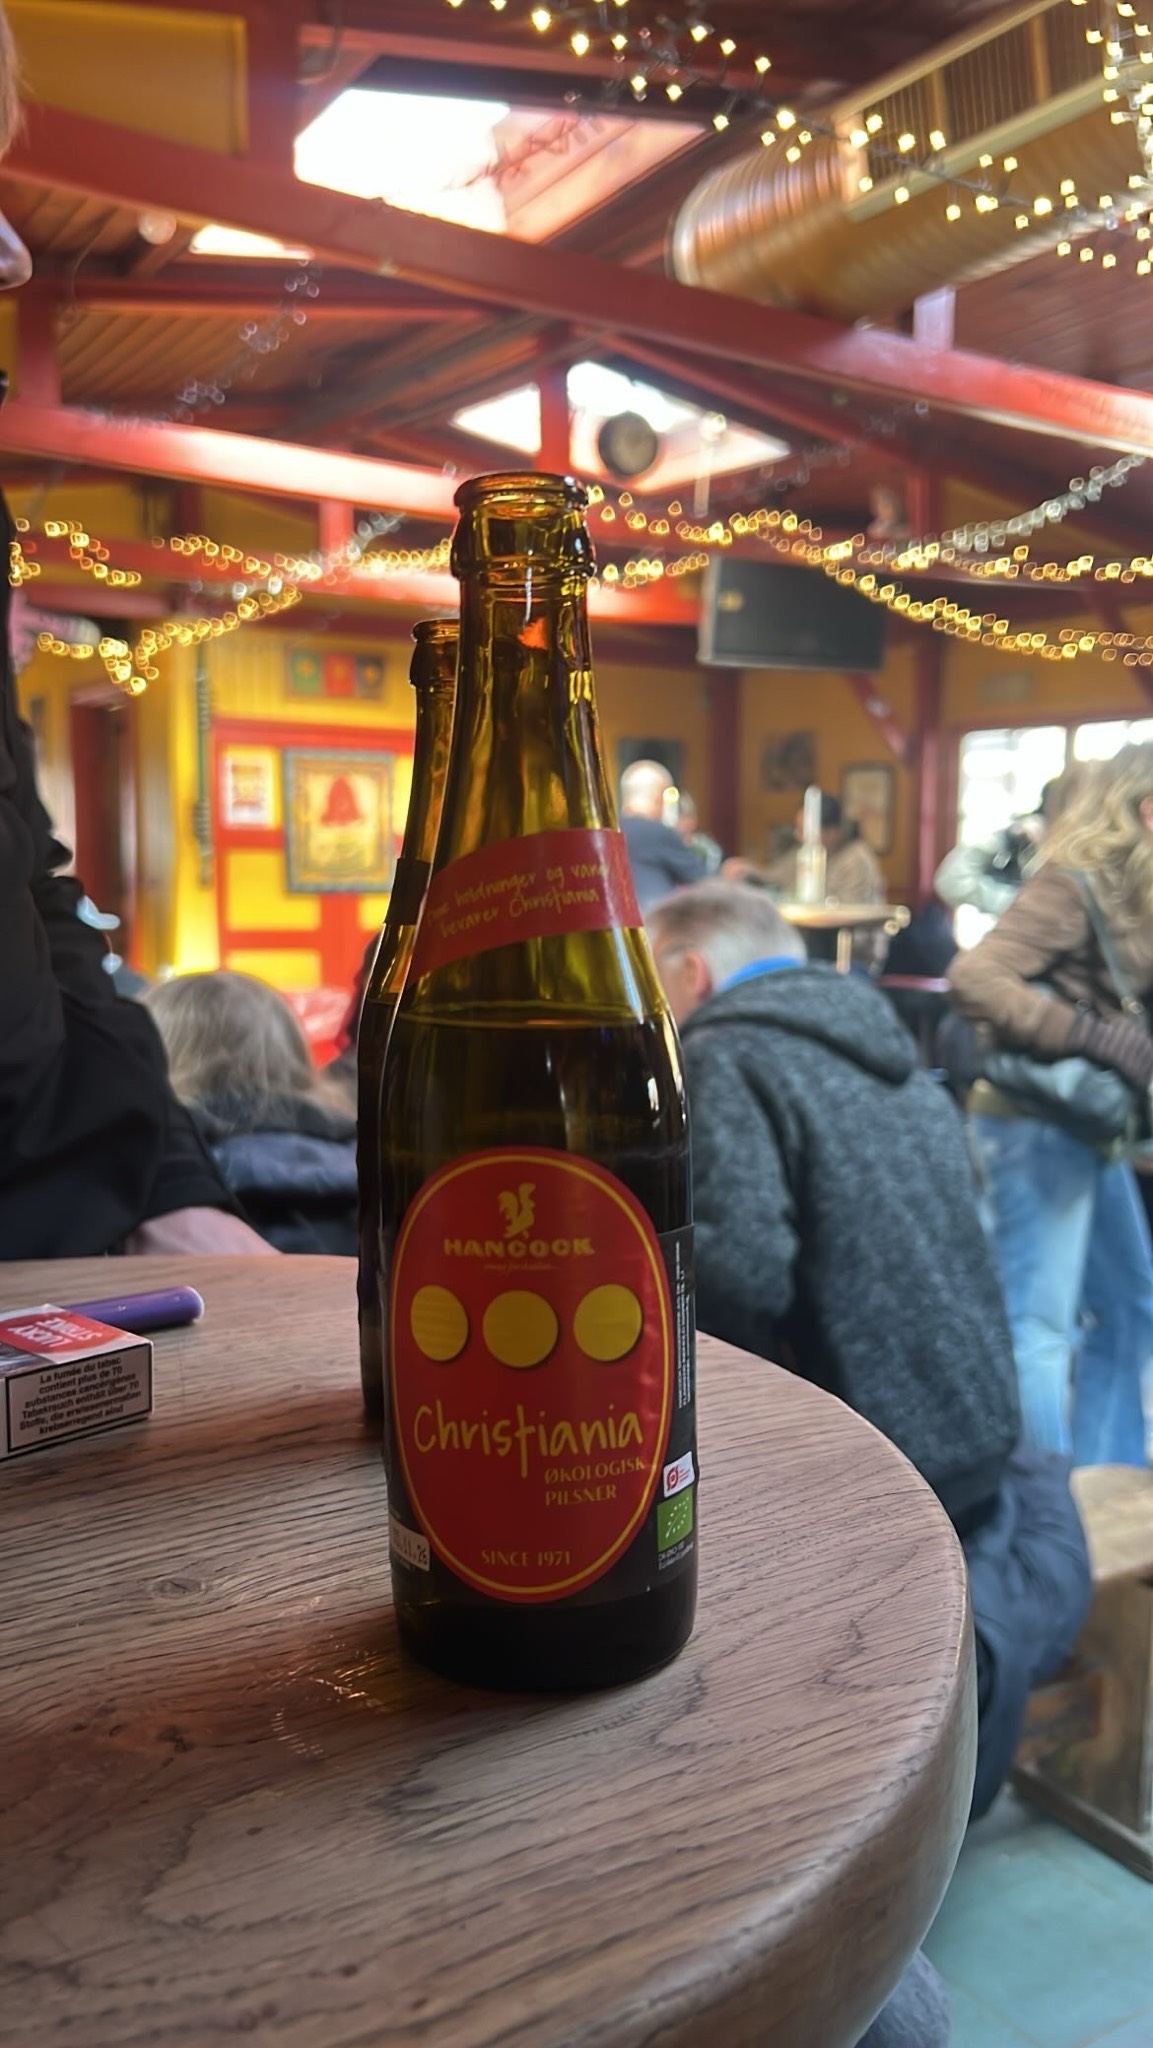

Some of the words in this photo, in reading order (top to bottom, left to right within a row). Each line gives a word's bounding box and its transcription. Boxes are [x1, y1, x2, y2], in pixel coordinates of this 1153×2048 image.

[546, 866, 564, 889] og
[509, 886, 599, 918] Christiania
[444, 1237, 595, 1258] HANCOCK
[39, 1378, 76, 1394] contient
[78, 1373, 97, 1386] plus
[99, 1370, 110, 1379] de
[112, 1365, 122, 1376] 70
[40, 1375, 51, 1384] La
[84, 1364, 96, 1373] du
[97, 1357, 121, 1369] tabac
[25, 1390, 76, 1408] substances
[414, 1399, 643, 1478] Christiania
[544, 1456, 645, 1485] ØKOLOGISK
[545, 1484, 617, 1506] PILSNER
[481, 1549, 528, 1567] SINCE
[538, 1551, 571, 1567] 1971
